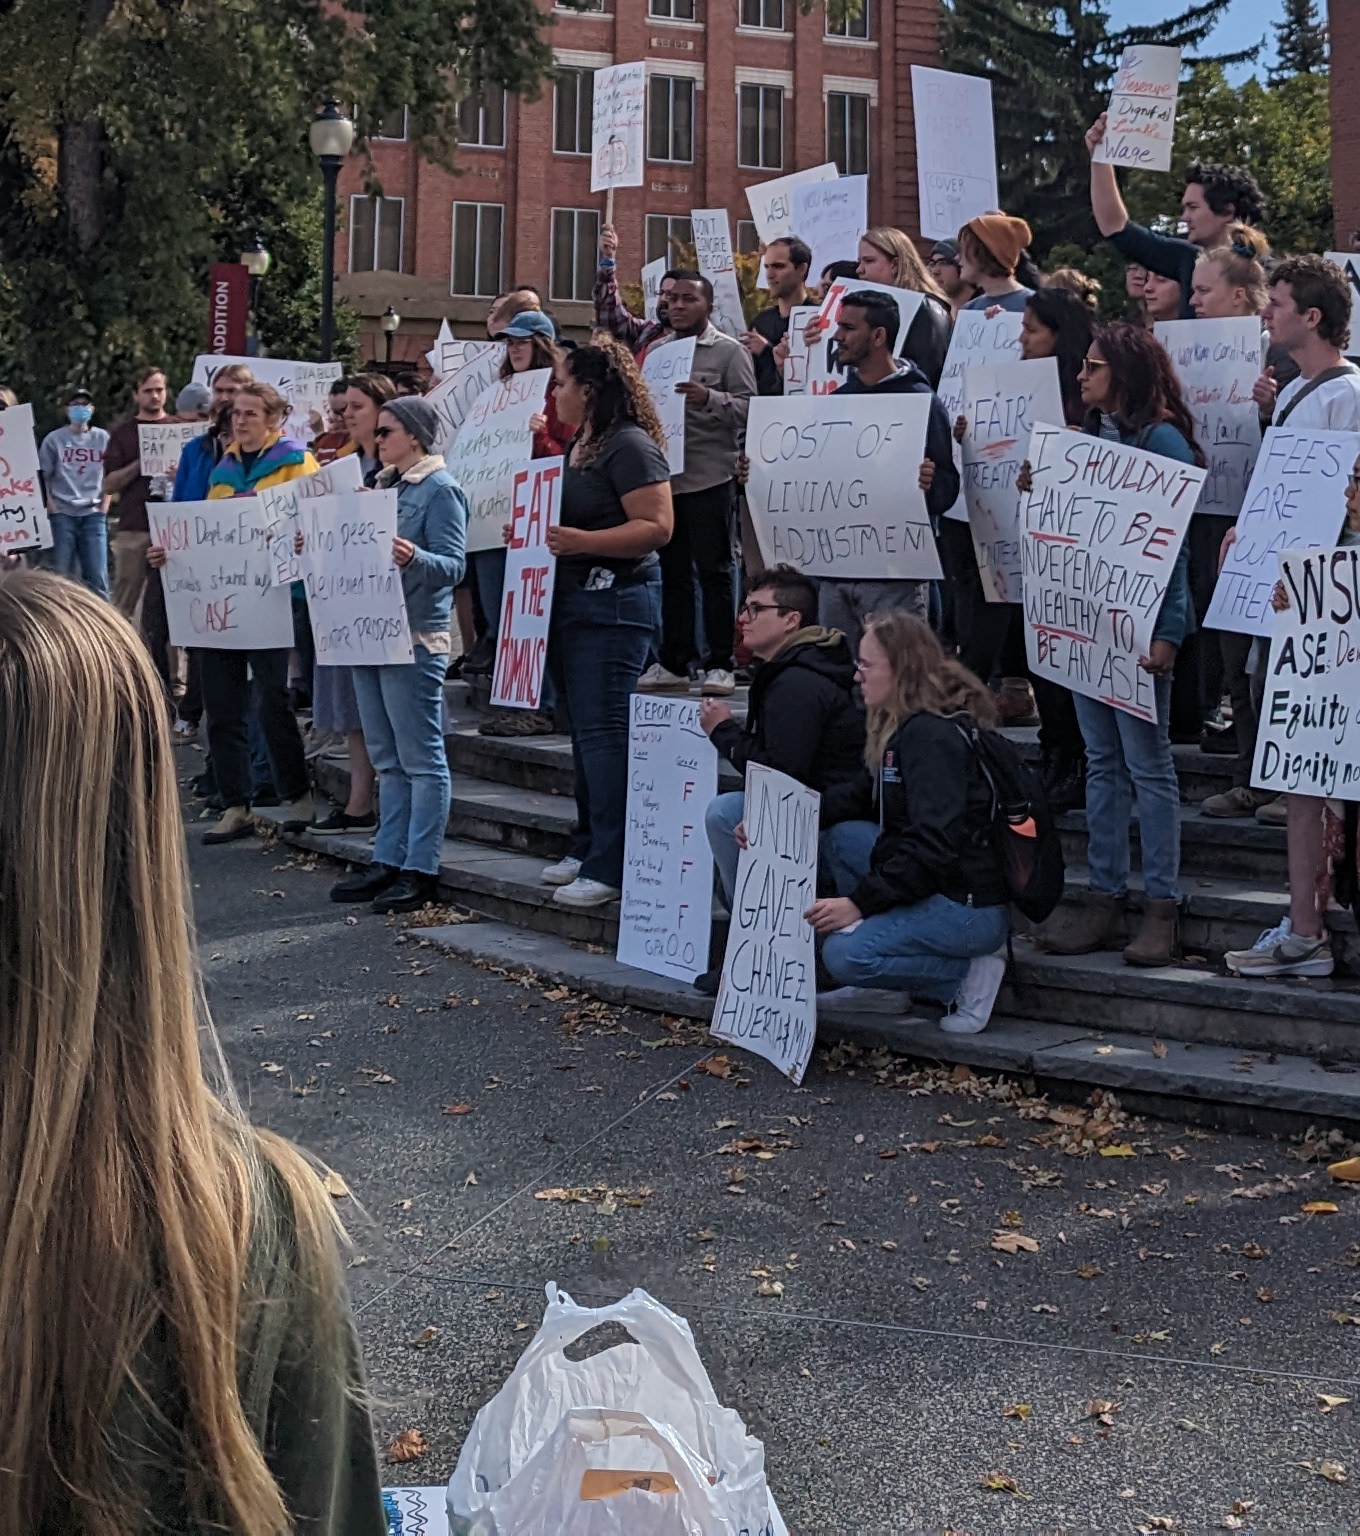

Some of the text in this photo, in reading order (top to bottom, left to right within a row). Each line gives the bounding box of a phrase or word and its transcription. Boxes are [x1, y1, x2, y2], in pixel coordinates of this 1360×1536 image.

[1105, 135, 1155, 166] Wage
[928, 174, 966, 193] COVER
[759, 420, 904, 464] COST OF
[1215, 417, 1243, 442] fair
[62, 448, 104, 465] WSU
[1030, 431, 1060, 475] I
[1058, 441, 1201, 509] SHOULDN'T
[1263, 433, 1341, 478] FEES
[509, 467, 560, 550] EAT
[766, 478, 868, 514] LIVING
[1243, 482, 1303, 527] ARE
[153, 515, 190, 552] WSU
[773, 520, 931, 567] ADJUSTMENT
[1025, 485, 1092, 537] HAVE
[1089, 500, 1118, 547] TO
[1119, 511, 1176, 560] BE
[520, 567, 549, 616] THE
[1021, 535, 1168, 619] INDEPENDENTLY
[190, 593, 240, 634] CASE
[1024, 582, 1103, 641] WEALTHY
[1107, 608, 1135, 654] TO
[492, 590, 545, 707] ADMINS
[1037, 630, 1151, 710] BE AN ASE
[634, 696, 676, 723] REPORT
[1270, 690, 1350, 745] Equity
[1260, 740, 1339, 796] Dignity
[683, 781, 695, 802] F
[682, 825, 694, 846] F
[747, 780, 818, 869] UNIONS
[680, 860, 694, 885] F
[679, 904, 689, 930] F
[739, 859, 796, 938] GAVE
